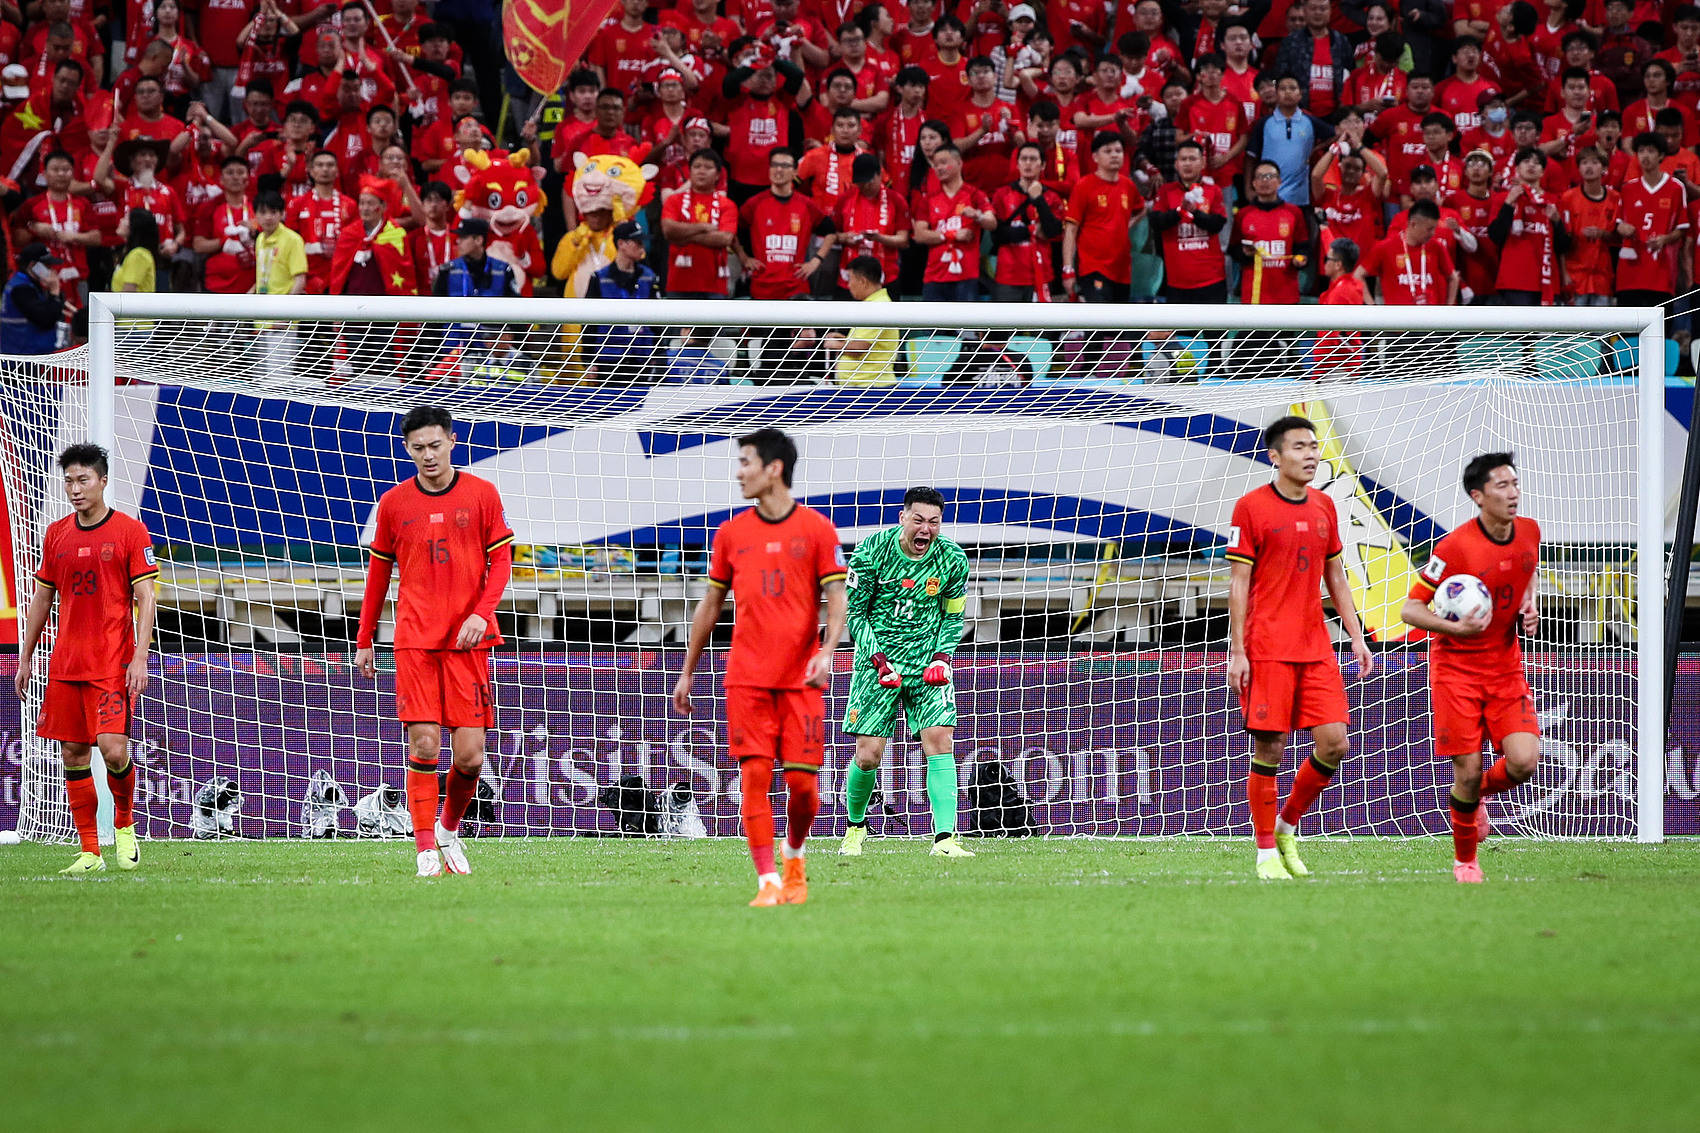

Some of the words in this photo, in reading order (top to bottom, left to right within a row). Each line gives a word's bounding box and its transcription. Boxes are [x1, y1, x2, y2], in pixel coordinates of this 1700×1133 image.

[1642, 213, 1654, 230] 5
[766, 234, 798, 250] 中国
[1178, 242, 1209, 251] CHINA
[1262, 259, 1286, 267] HINA
[427, 538, 449, 564] 16
[1297, 546, 1309, 572] 6
[72, 570, 97, 596] 23
[761, 569, 785, 597] 10
[1494, 584, 1513, 611] 19
[98, 691, 123, 716] 23
[804, 715, 823, 743] 10
